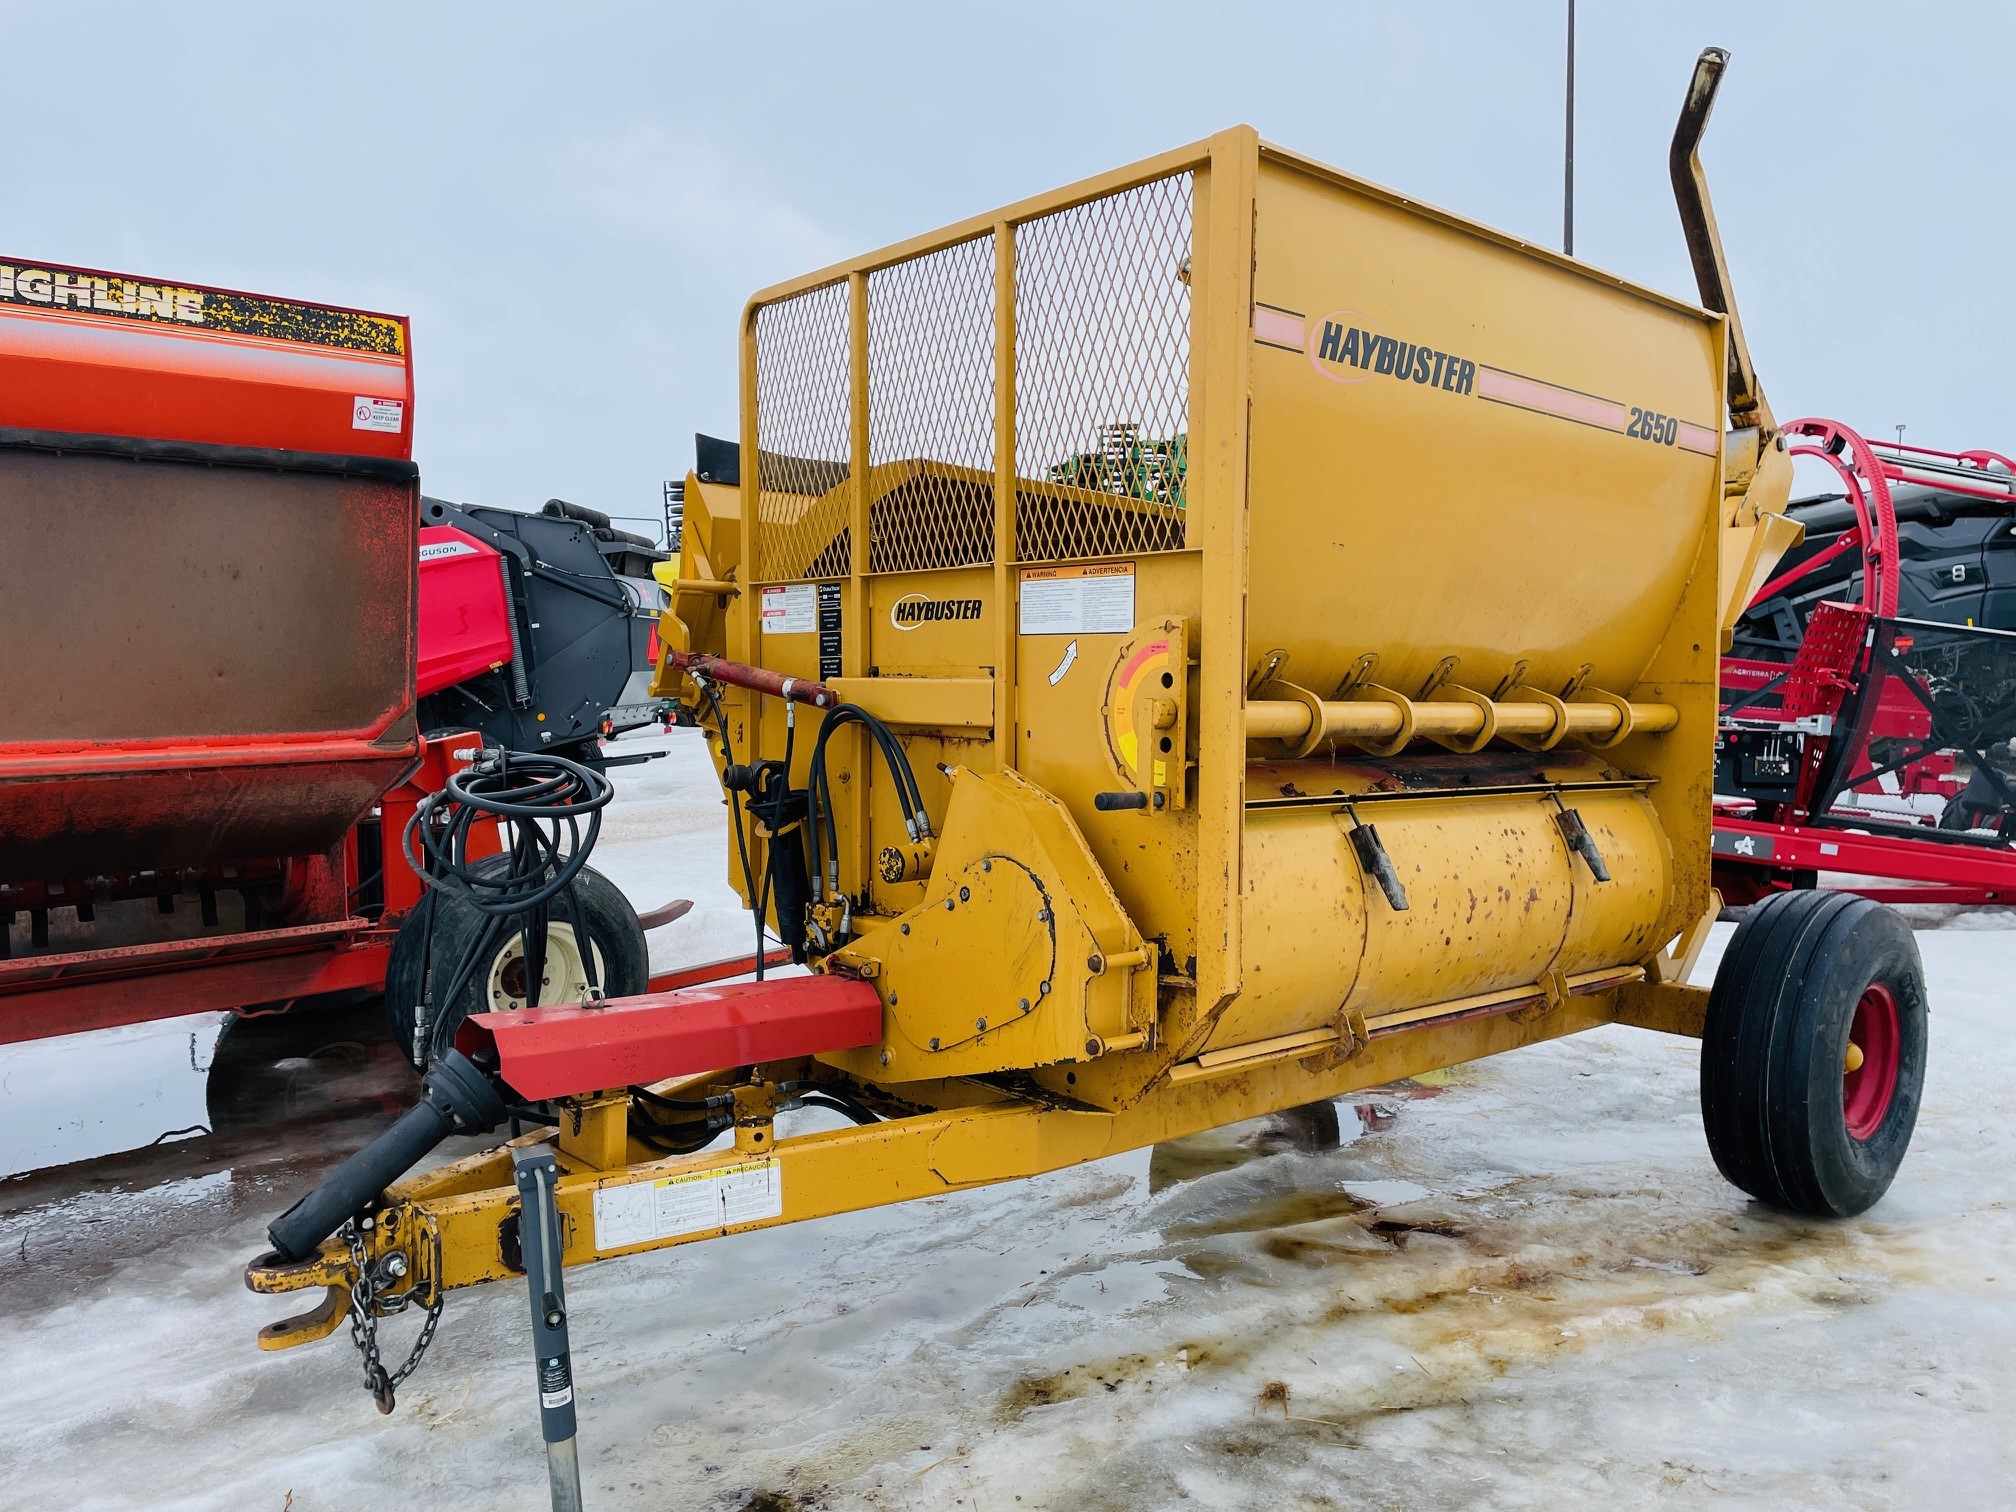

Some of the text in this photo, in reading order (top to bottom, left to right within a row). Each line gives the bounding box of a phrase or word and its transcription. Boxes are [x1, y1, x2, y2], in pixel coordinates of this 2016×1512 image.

[0, 265, 204, 322] IGHLINE
[1318, 321, 1476, 396] HAYBUSTER
[1627, 407, 1678, 446] 2650
[1032, 570, 1057, 578] WARNING
[1088, 566, 1128, 575] ADVERTENCIA
[1952, 564, 1966, 582] 8
[896, 599, 982, 622] HAYBUSTER
[1733, 668, 1769, 678] AGRITERRA
[675, 1174, 702, 1184] CAUTION
